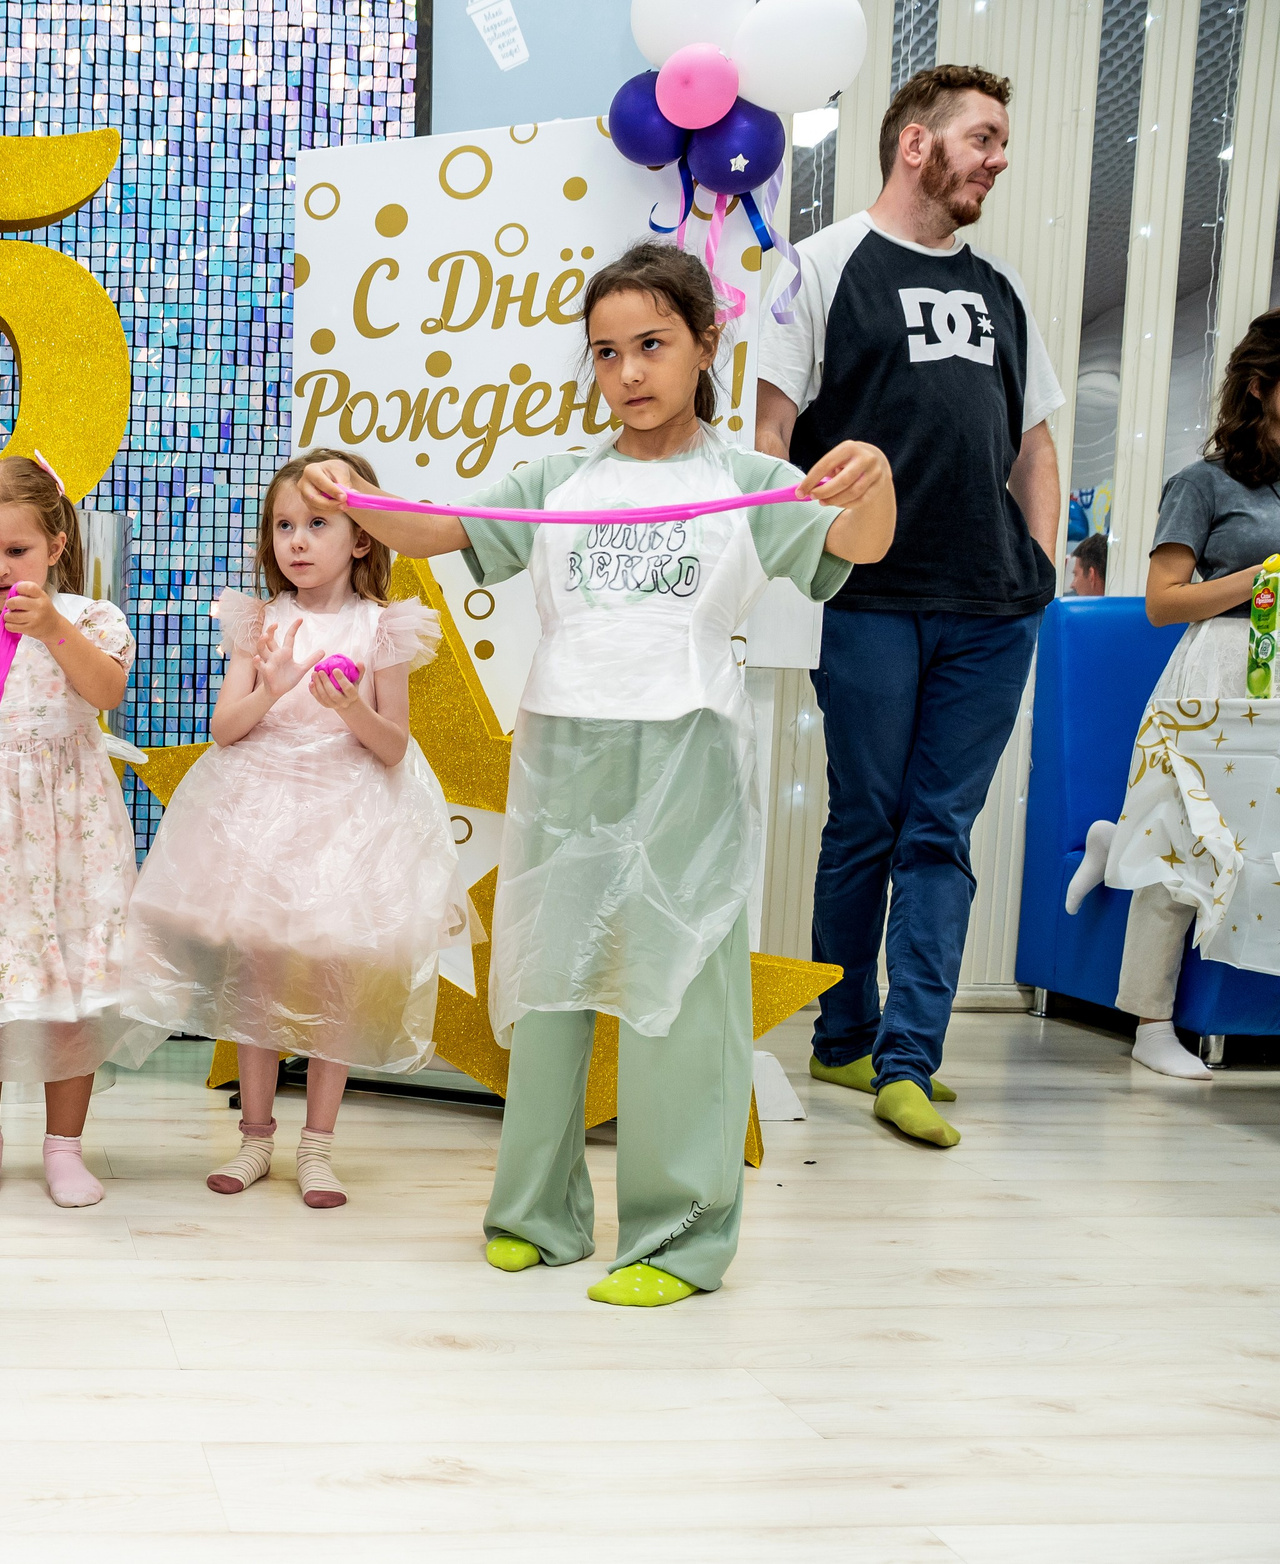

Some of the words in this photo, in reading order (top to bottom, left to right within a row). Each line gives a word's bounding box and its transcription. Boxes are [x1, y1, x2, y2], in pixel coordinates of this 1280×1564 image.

[353, 257, 399, 339] С
[420, 246, 595, 335] Днё
[898, 287, 995, 367] DC
